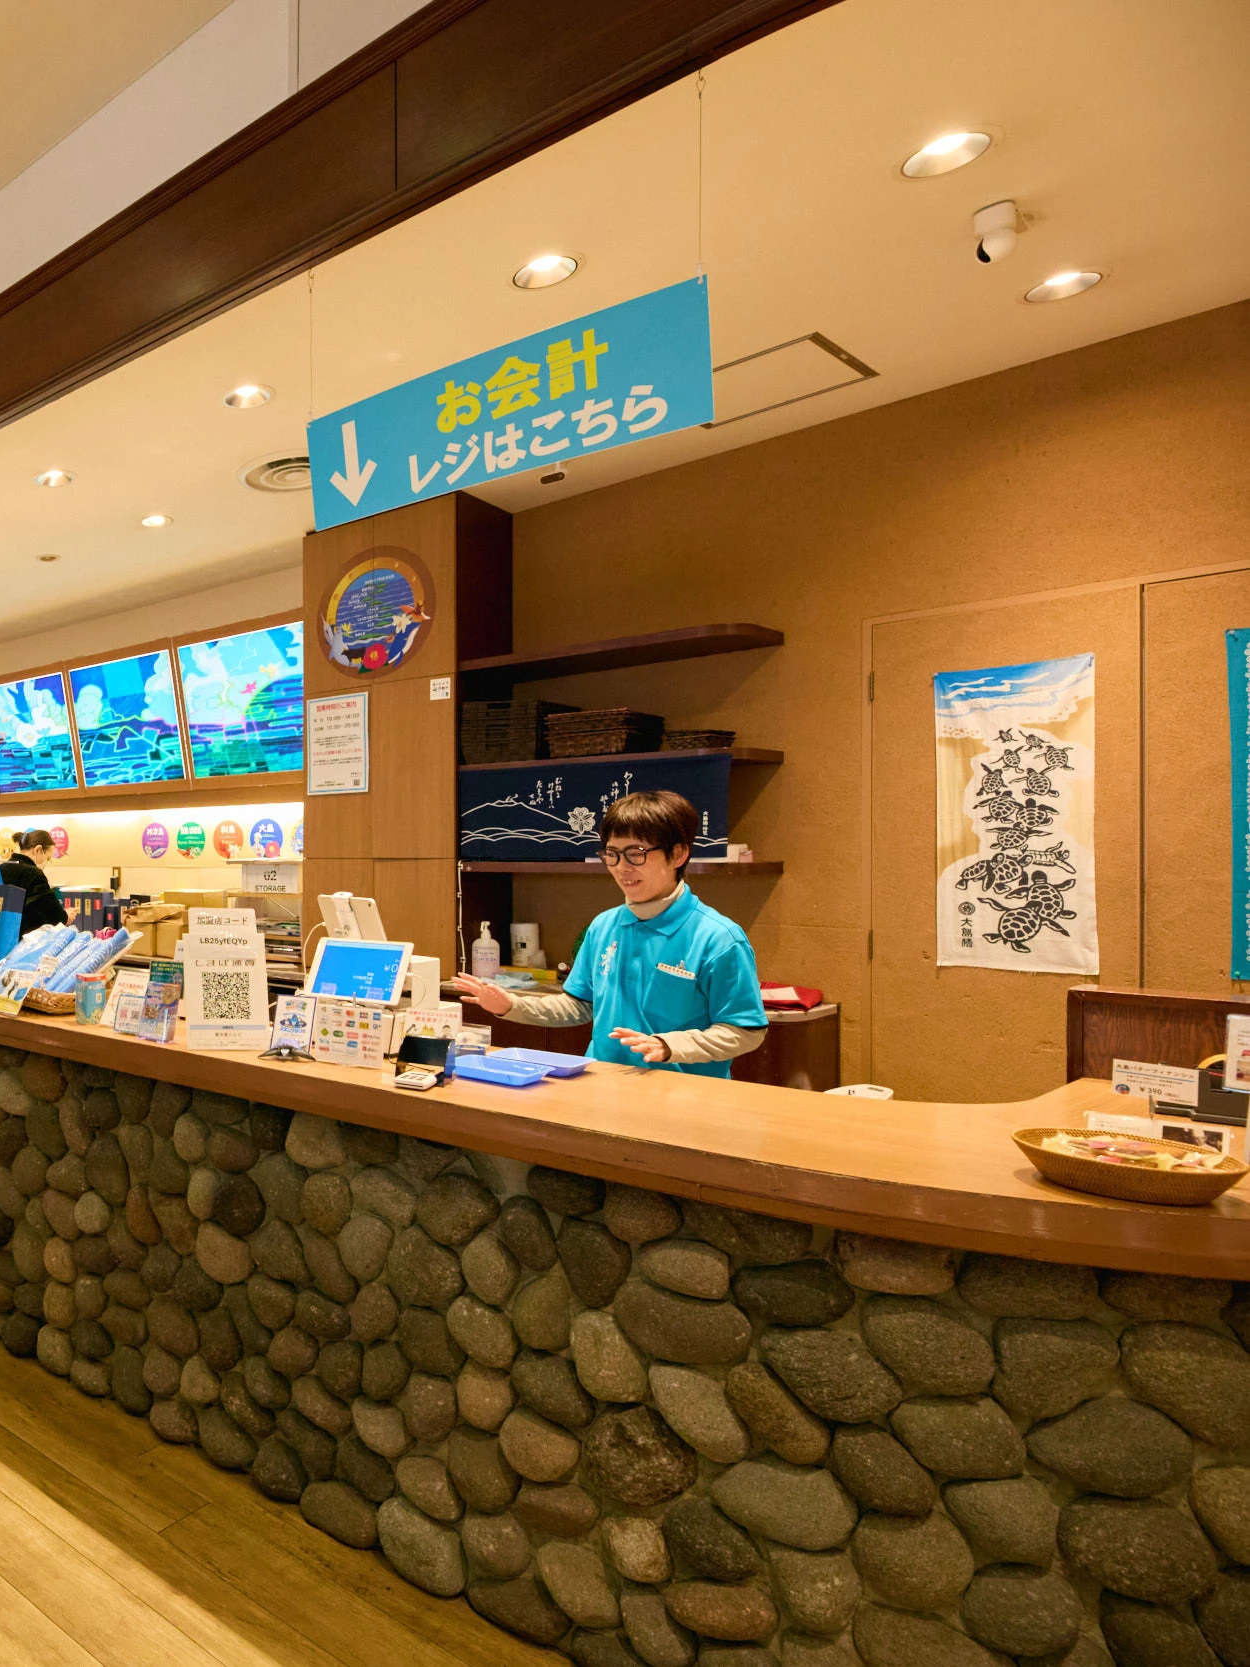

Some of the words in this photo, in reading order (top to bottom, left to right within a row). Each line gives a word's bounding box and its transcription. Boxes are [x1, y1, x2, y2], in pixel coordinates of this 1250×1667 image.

[436, 328, 609, 434] お会計
[408, 385, 668, 494] レジはこちら
[258, 823, 275, 833] 大島
[197, 915, 248, 925] 加盟店コード
